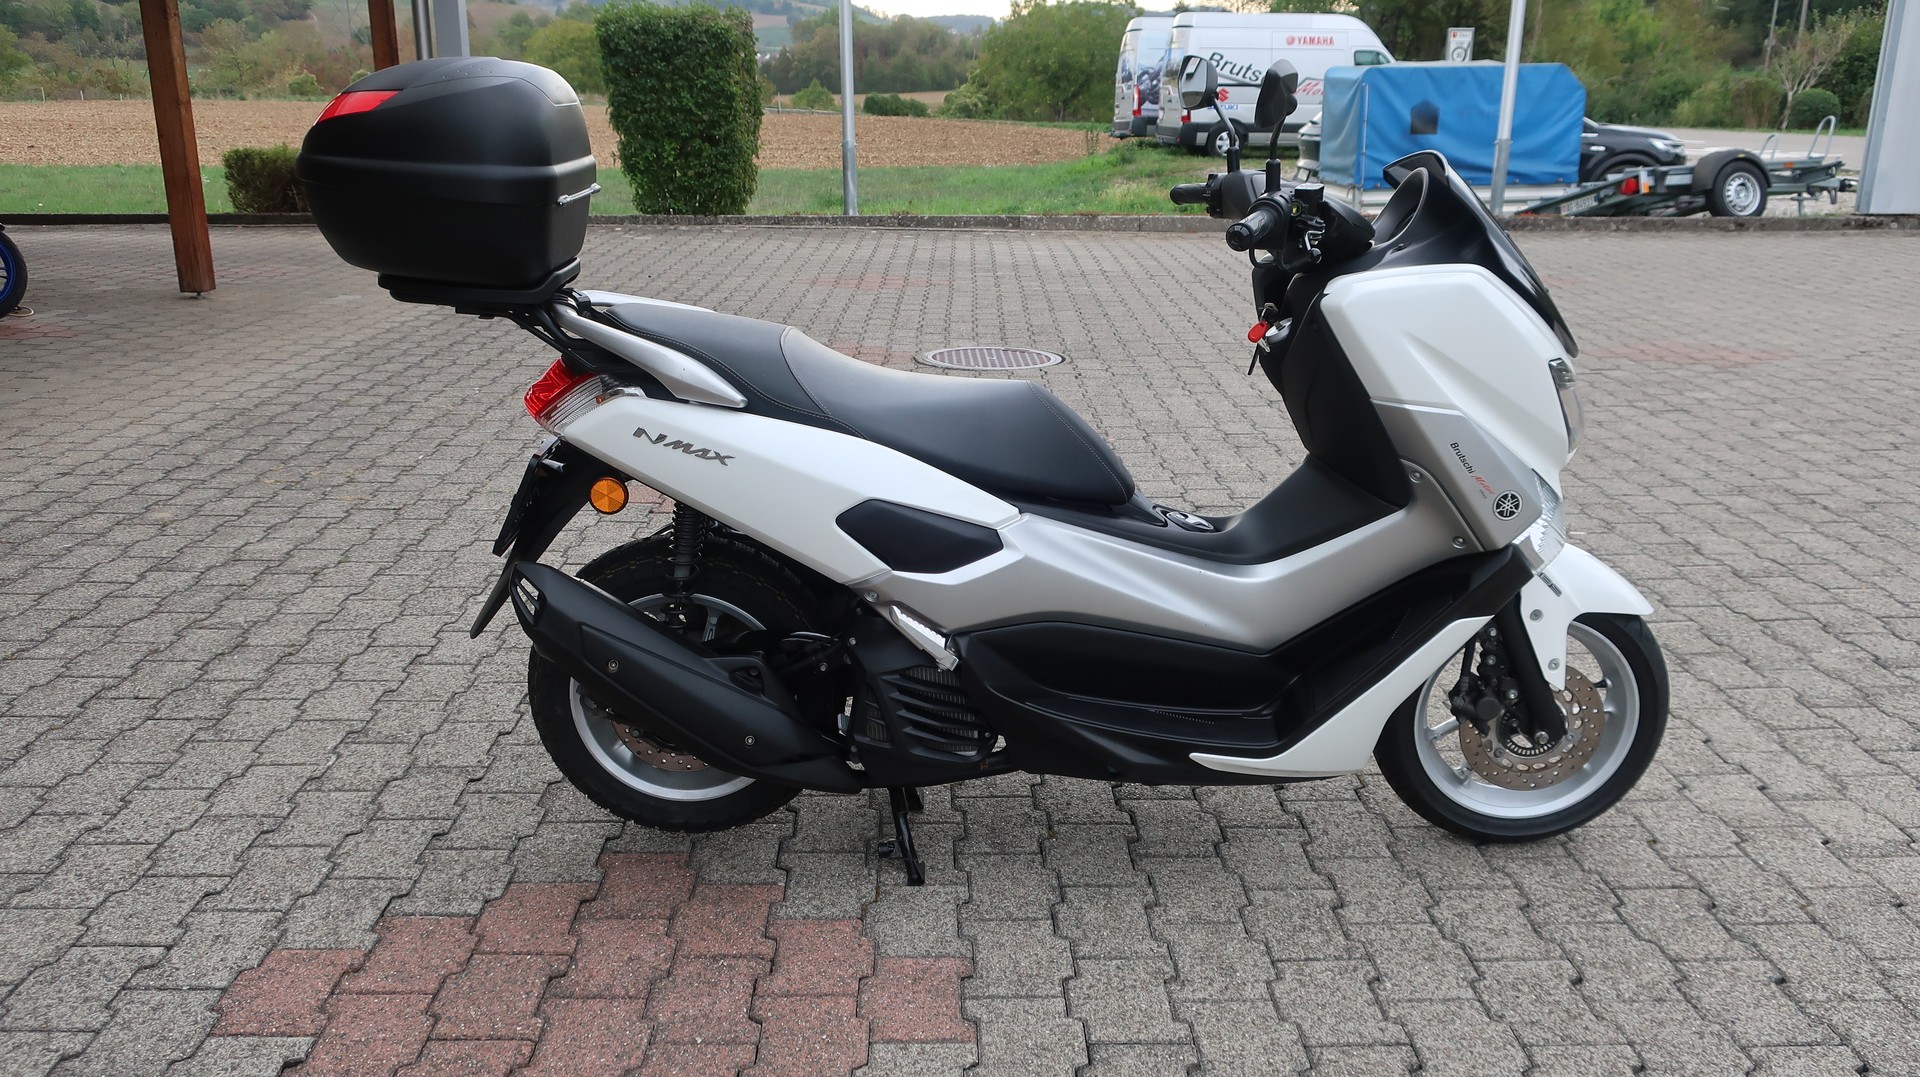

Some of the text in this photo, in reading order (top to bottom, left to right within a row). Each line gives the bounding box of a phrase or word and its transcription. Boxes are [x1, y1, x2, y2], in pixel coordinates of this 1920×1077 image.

[1297, 35, 1335, 46] YAMAHA
[1209, 52, 1264, 83] Bruts
[632, 426, 736, 467] NMAX
[1450, 442, 1475, 475] Brutschi
